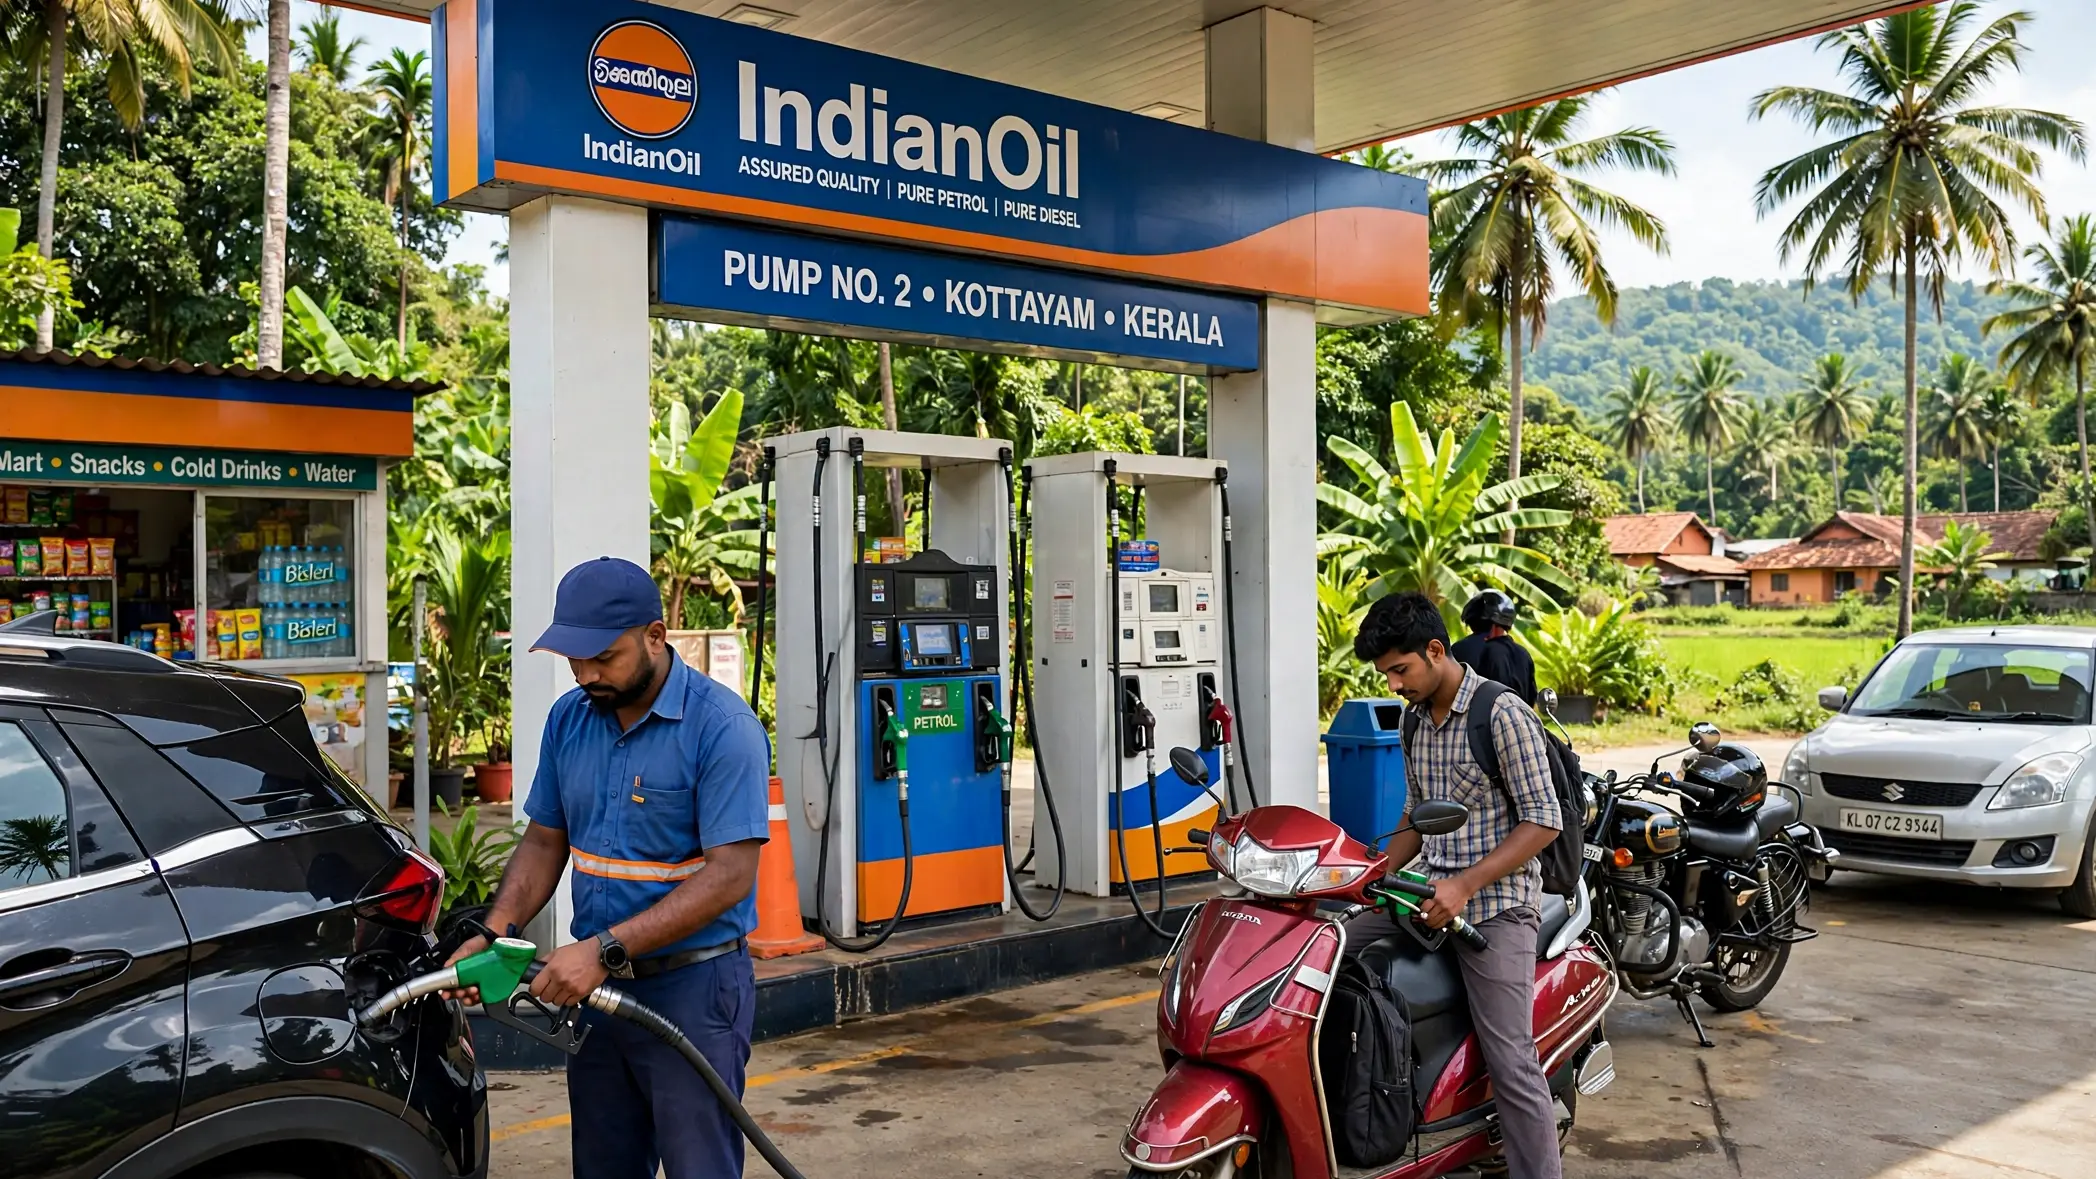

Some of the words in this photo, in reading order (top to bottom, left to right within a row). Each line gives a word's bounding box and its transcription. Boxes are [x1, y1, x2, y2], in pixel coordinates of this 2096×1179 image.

[738, 59, 1079, 199] IndianOil
[583, 132, 701, 177] IndianOil
[738, 155, 814, 185] ASSURED
[816, 167, 881, 196] QUALITY
[897, 182, 935, 205] PURE
[937, 191, 990, 214] PETROL
[1003, 200, 1037, 222] PURE
[1039, 207, 1082, 229] DIESEL
[724, 249, 823, 297] PUMP
[831, 264, 886, 305] NO.
[893, 273, 912, 309] 2
[945, 279, 1096, 331] KOTTAYAM
[1123, 303, 1225, 348] KERALA
[0, 450, 44, 473] Mart
[70, 452, 146, 477] Snacks
[170, 456, 216, 479] Cold
[221, 458, 282, 481] Drinks
[304, 462, 357, 484] Water
[914, 714, 958, 730] PETROL
[1847, 812, 1862, 828] KL
[1865, 814, 1881, 830] 07
[1884, 816, 1901, 832] CZ
